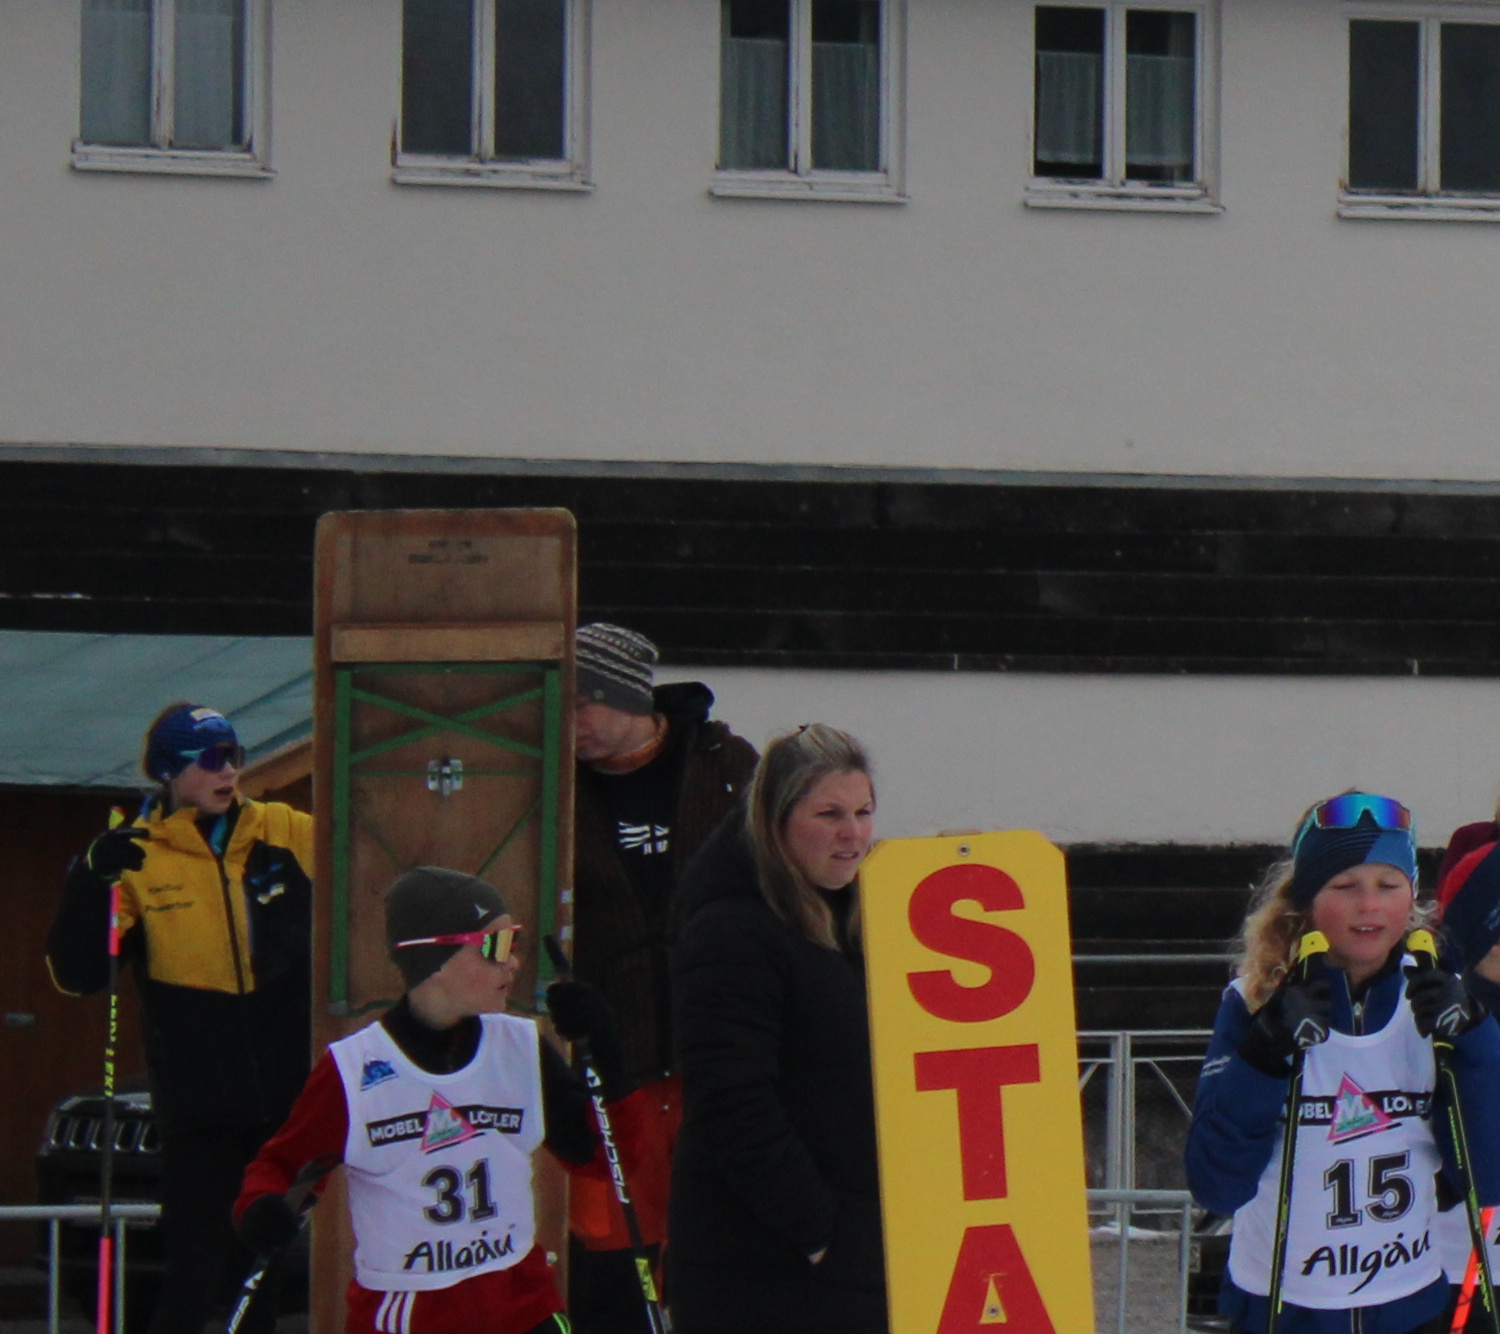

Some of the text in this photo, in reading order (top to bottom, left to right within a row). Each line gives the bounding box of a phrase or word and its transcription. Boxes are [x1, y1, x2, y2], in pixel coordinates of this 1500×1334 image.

[591, 1094, 630, 1204] FISCHER
[420, 1158, 499, 1227] 31
[1323, 1149, 1416, 1230] 15
[402, 1230, 514, 1273] Allgäu
[1300, 1231, 1432, 1295] Allgäu
